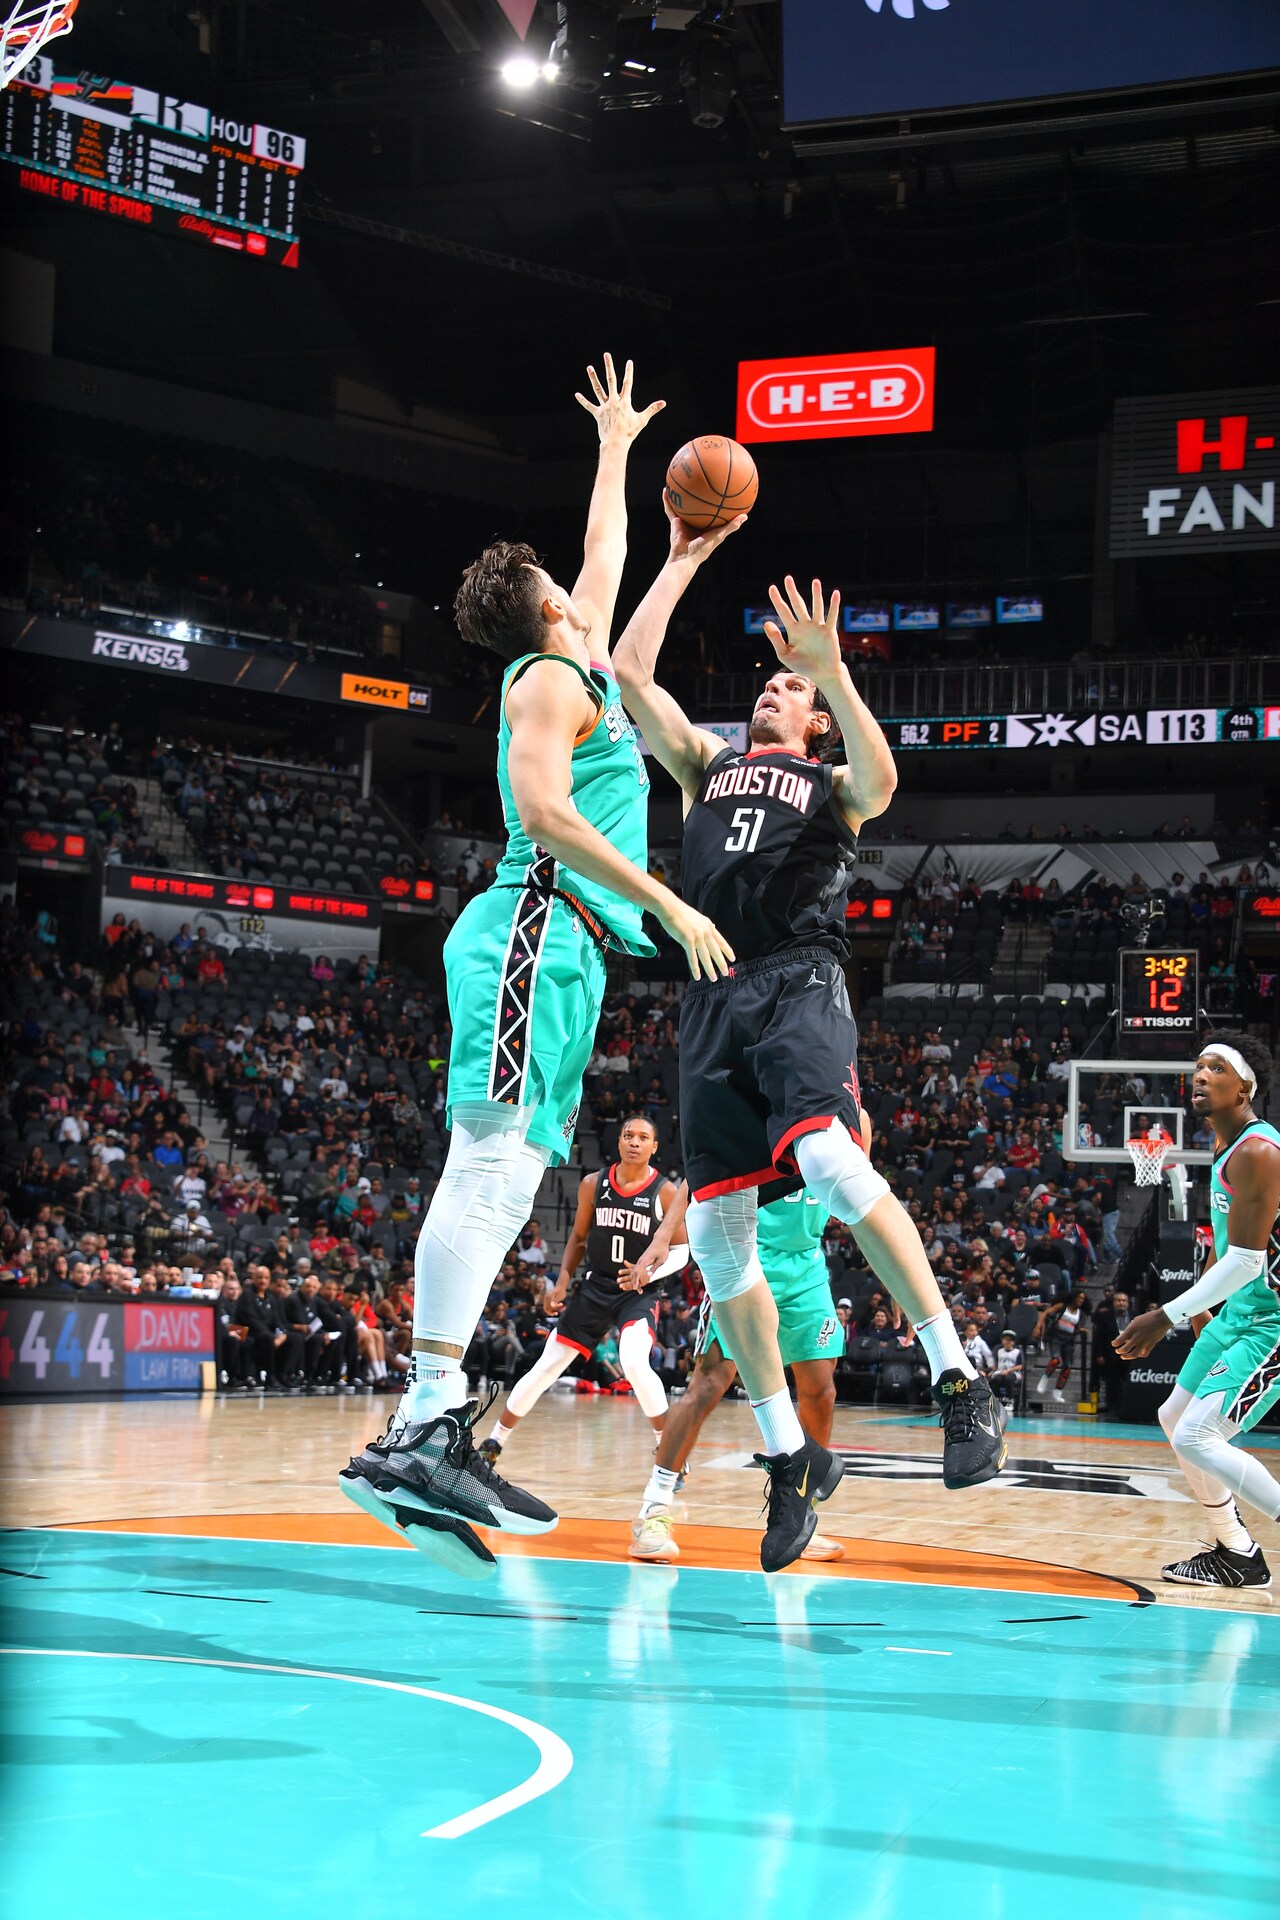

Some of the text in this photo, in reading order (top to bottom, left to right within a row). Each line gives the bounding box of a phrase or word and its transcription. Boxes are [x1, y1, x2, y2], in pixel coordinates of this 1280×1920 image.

[210, 116, 253, 147] HOU
[267, 131, 295, 162] 96
[20, 169, 153, 224] HOME OF THE SPURS
[1142, 481, 1275, 535] FAN
[354, 684, 403, 700] HOLT
[711, 727, 739, 737] BLK
[1099, 714, 1206, 742] SA 113
[1229, 714, 1253, 726] 4th
[900, 722, 999, 745] 56.2 PF 2
[1231, 730, 1250, 740] QTR
[703, 765, 813, 815] HOUSTON
[724, 807, 766, 853] 51
[859, 851, 881, 863] 113
[241, 917, 264, 932] 112
[1144, 956, 1188, 977] 3:42
[1150, 977, 1182, 1012] 12
[1143, 1017, 1193, 1027] TISSOT
[595, 1207, 651, 1236] HOUSTON
[611, 1235, 625, 1263] 0
[1160, 1268, 1194, 1282] Sprite
[140, 1309, 201, 1348] DAVIS
[141, 1359, 169, 1381] LAW
